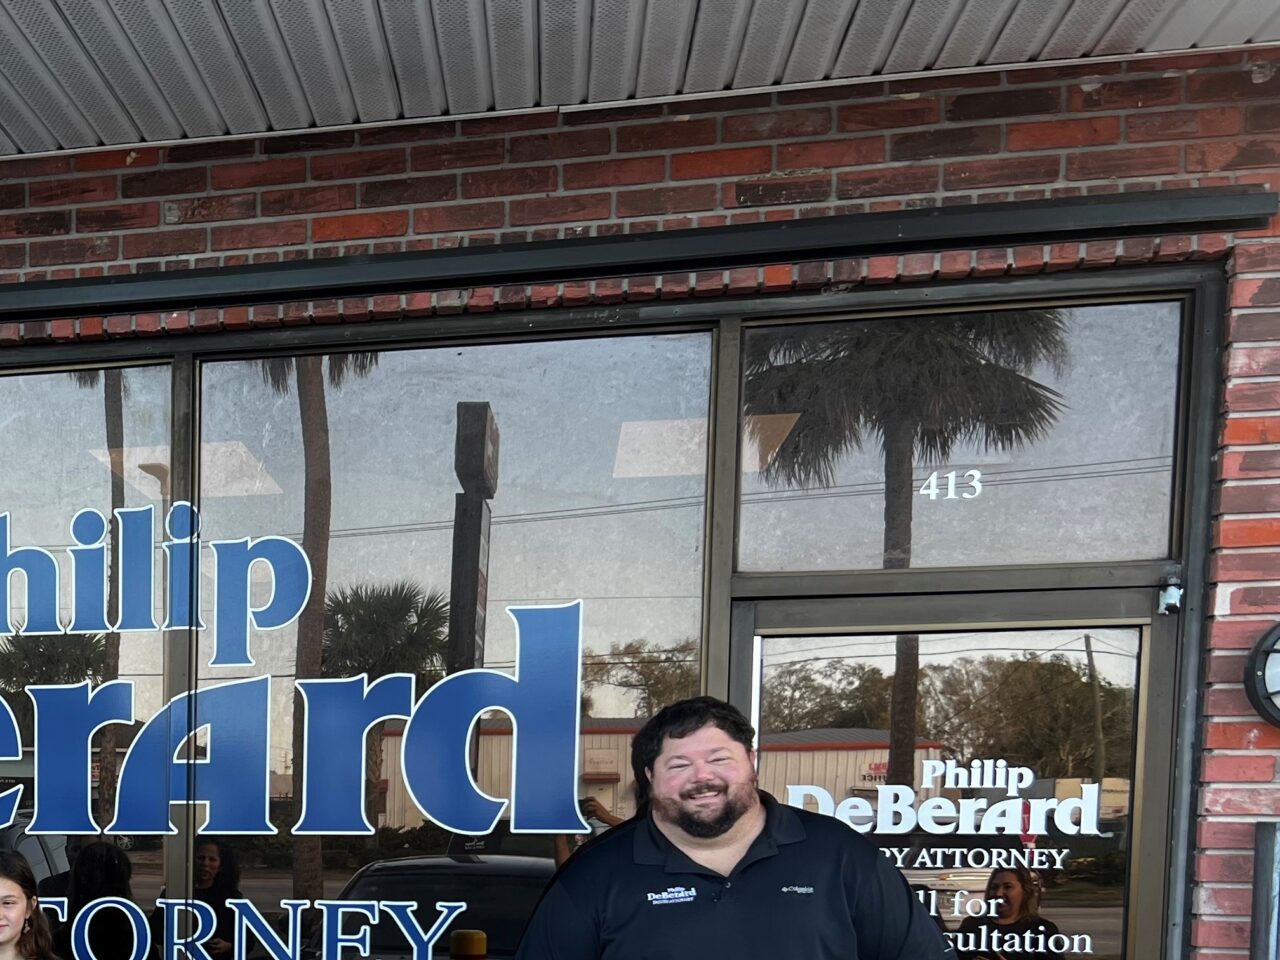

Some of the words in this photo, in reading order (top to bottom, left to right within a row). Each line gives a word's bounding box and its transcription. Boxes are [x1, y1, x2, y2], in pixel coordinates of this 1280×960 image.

[919, 469, 983, 501] 413
[921, 758, 1035, 797] Philip
[913, 847, 1070, 870] ATTORNEY
[952, 890, 1005, 917] for
[942, 924, 1094, 954] sultation
